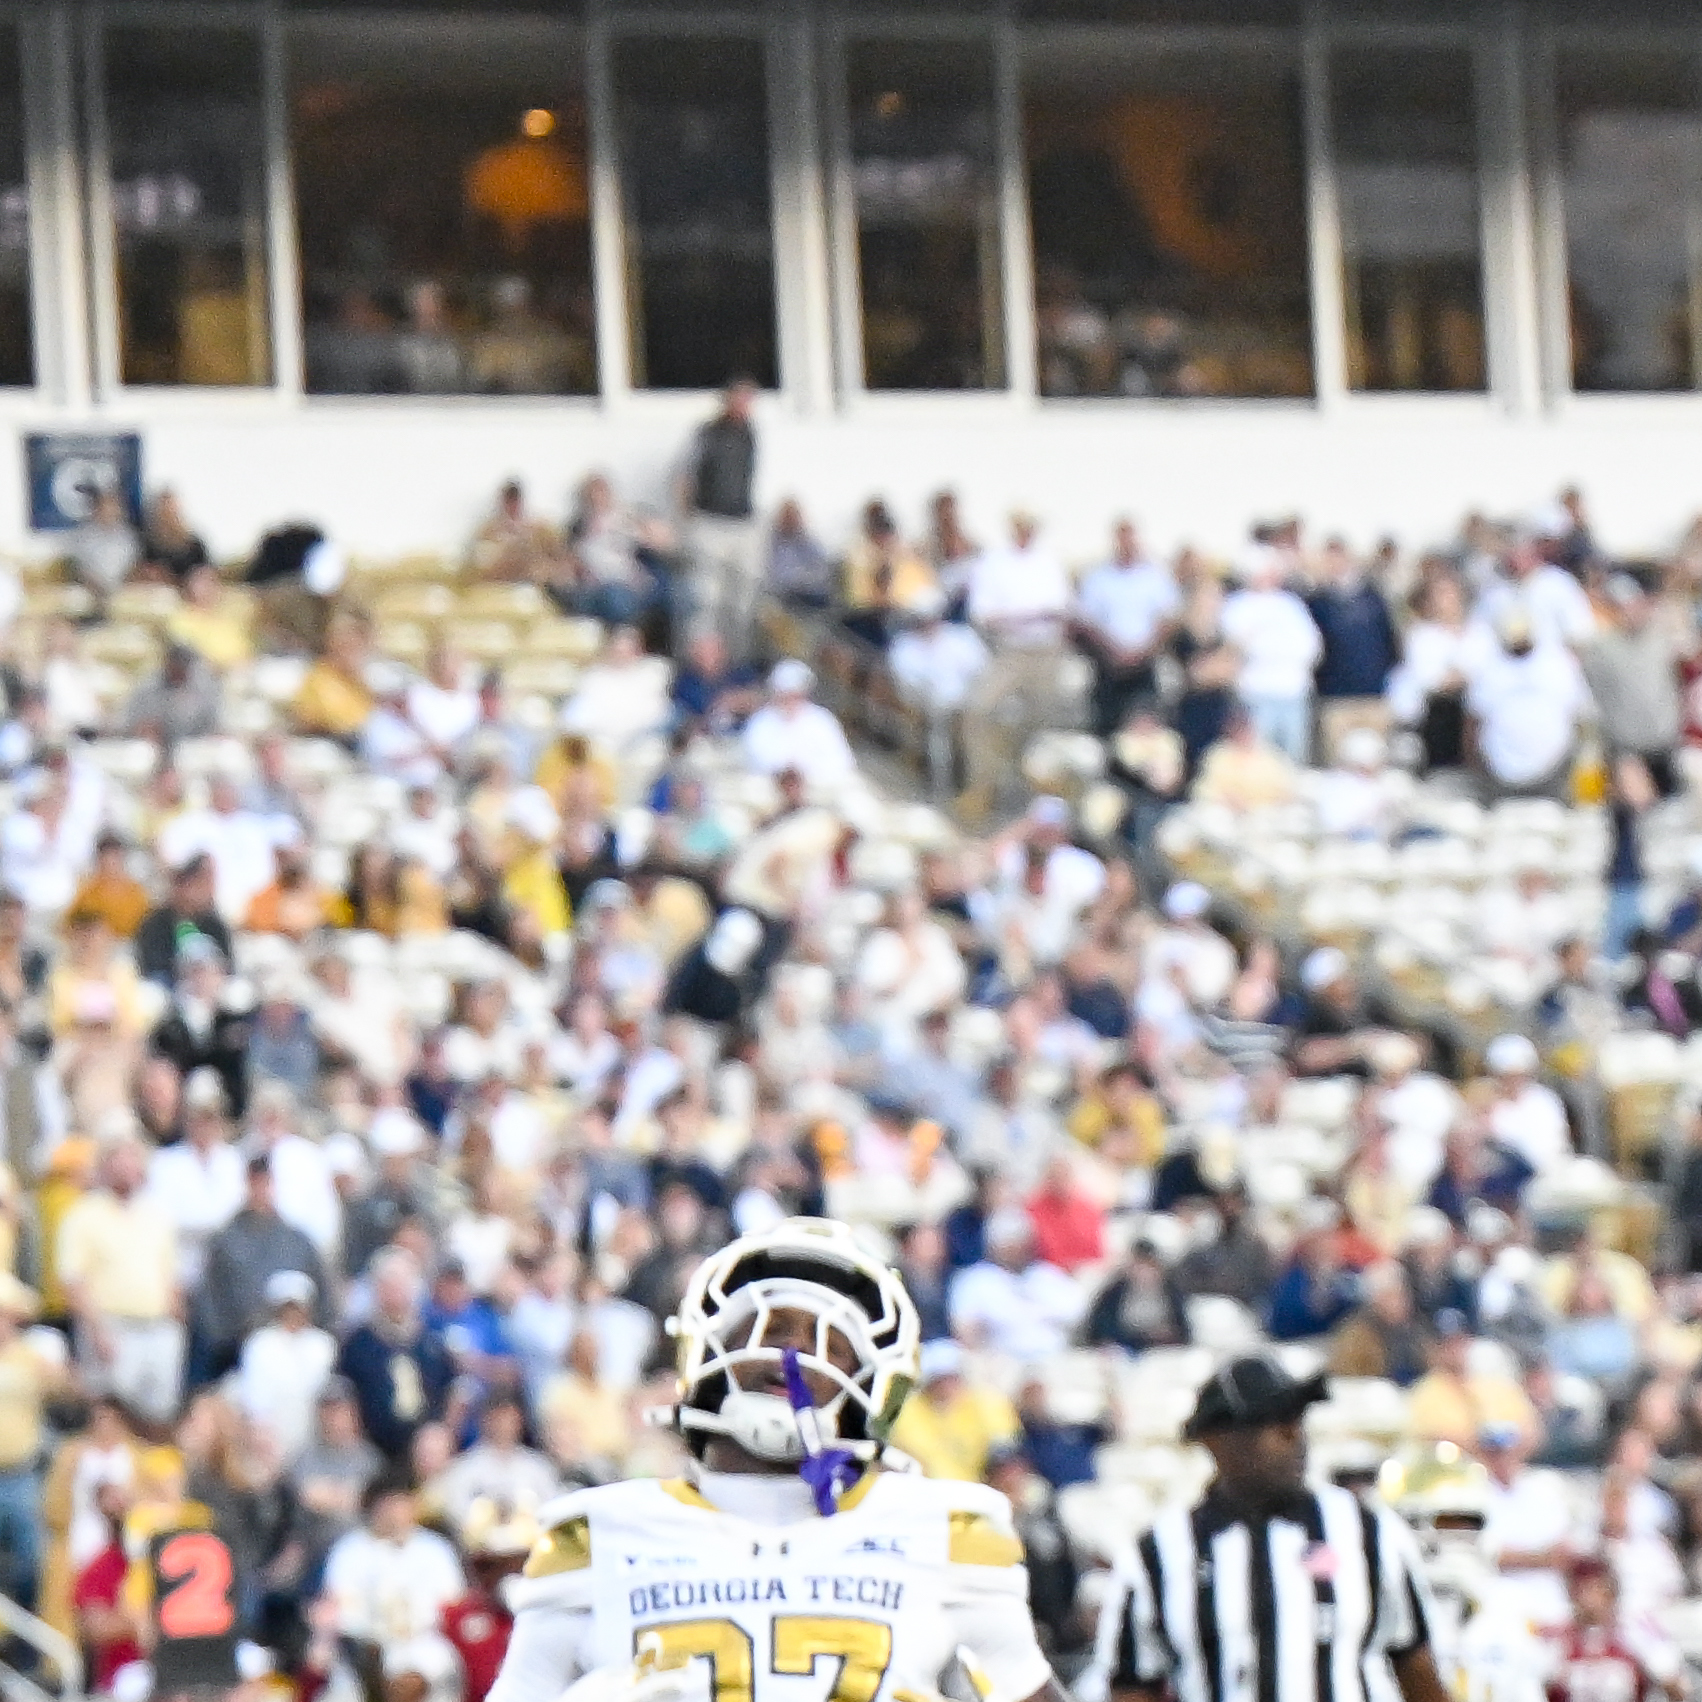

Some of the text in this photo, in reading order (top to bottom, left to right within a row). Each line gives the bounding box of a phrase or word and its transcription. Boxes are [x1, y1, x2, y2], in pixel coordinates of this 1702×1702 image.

[158, 1532, 235, 1640] 2
[628, 1574, 905, 1616] GEORGIA TECH
